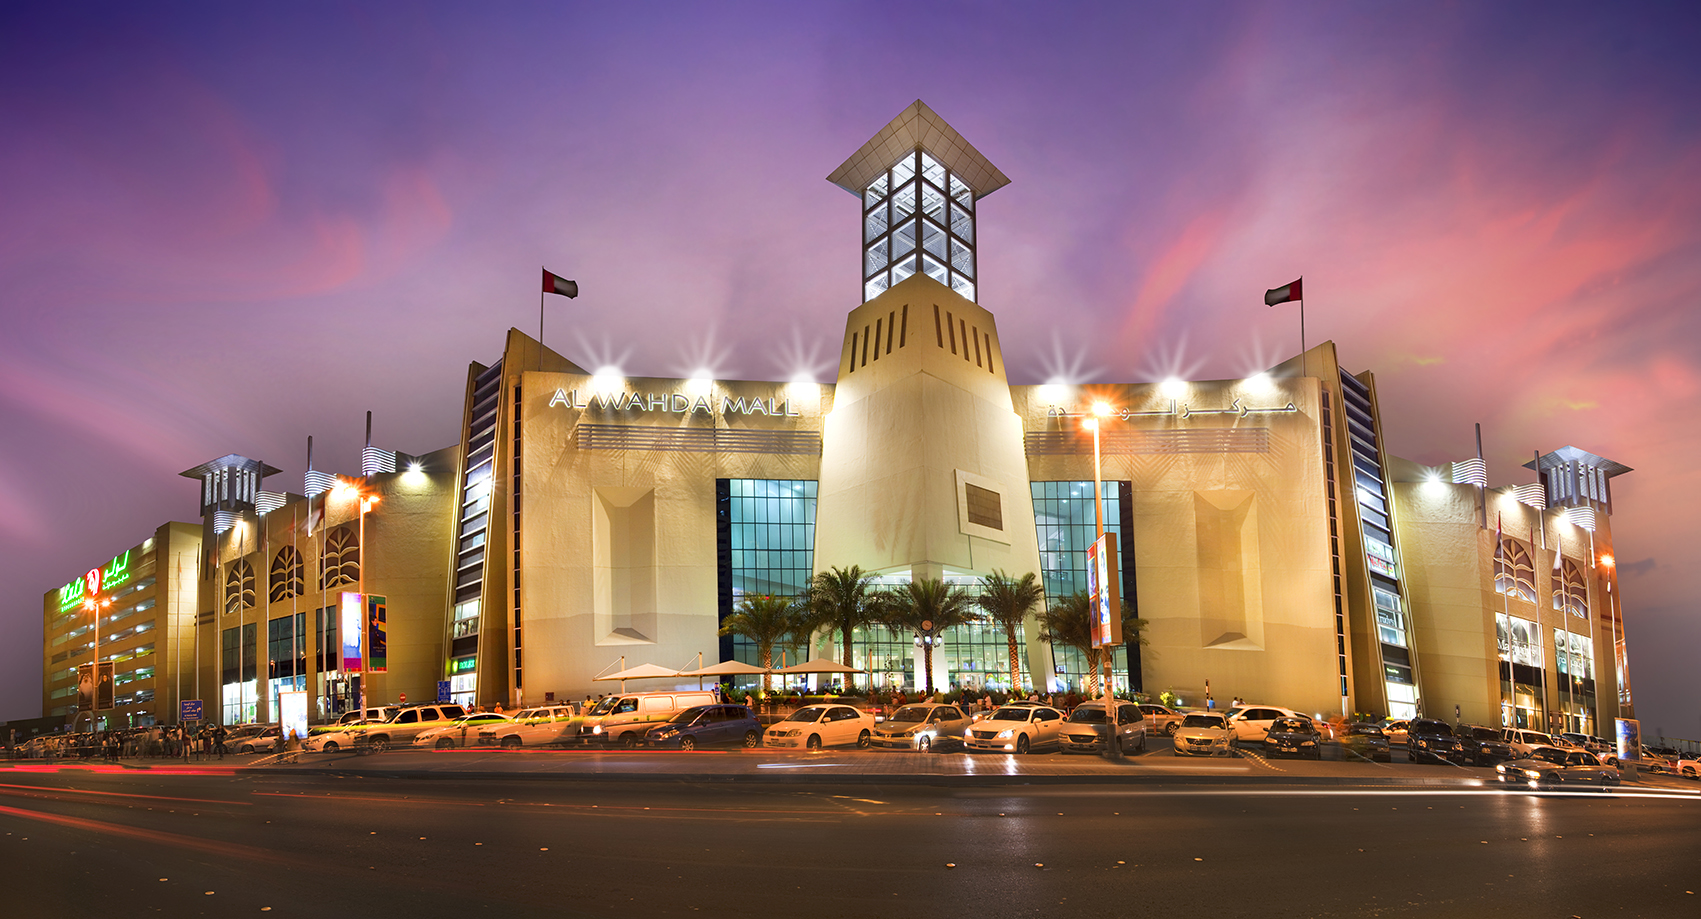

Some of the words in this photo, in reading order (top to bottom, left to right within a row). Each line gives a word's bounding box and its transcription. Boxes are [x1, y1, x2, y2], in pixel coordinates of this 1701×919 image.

[549, 388, 587, 408] AL
[595, 391, 712, 413] WAHDA
[721, 395, 799, 416] MALL
[1182, 398, 1298, 418] مركز
